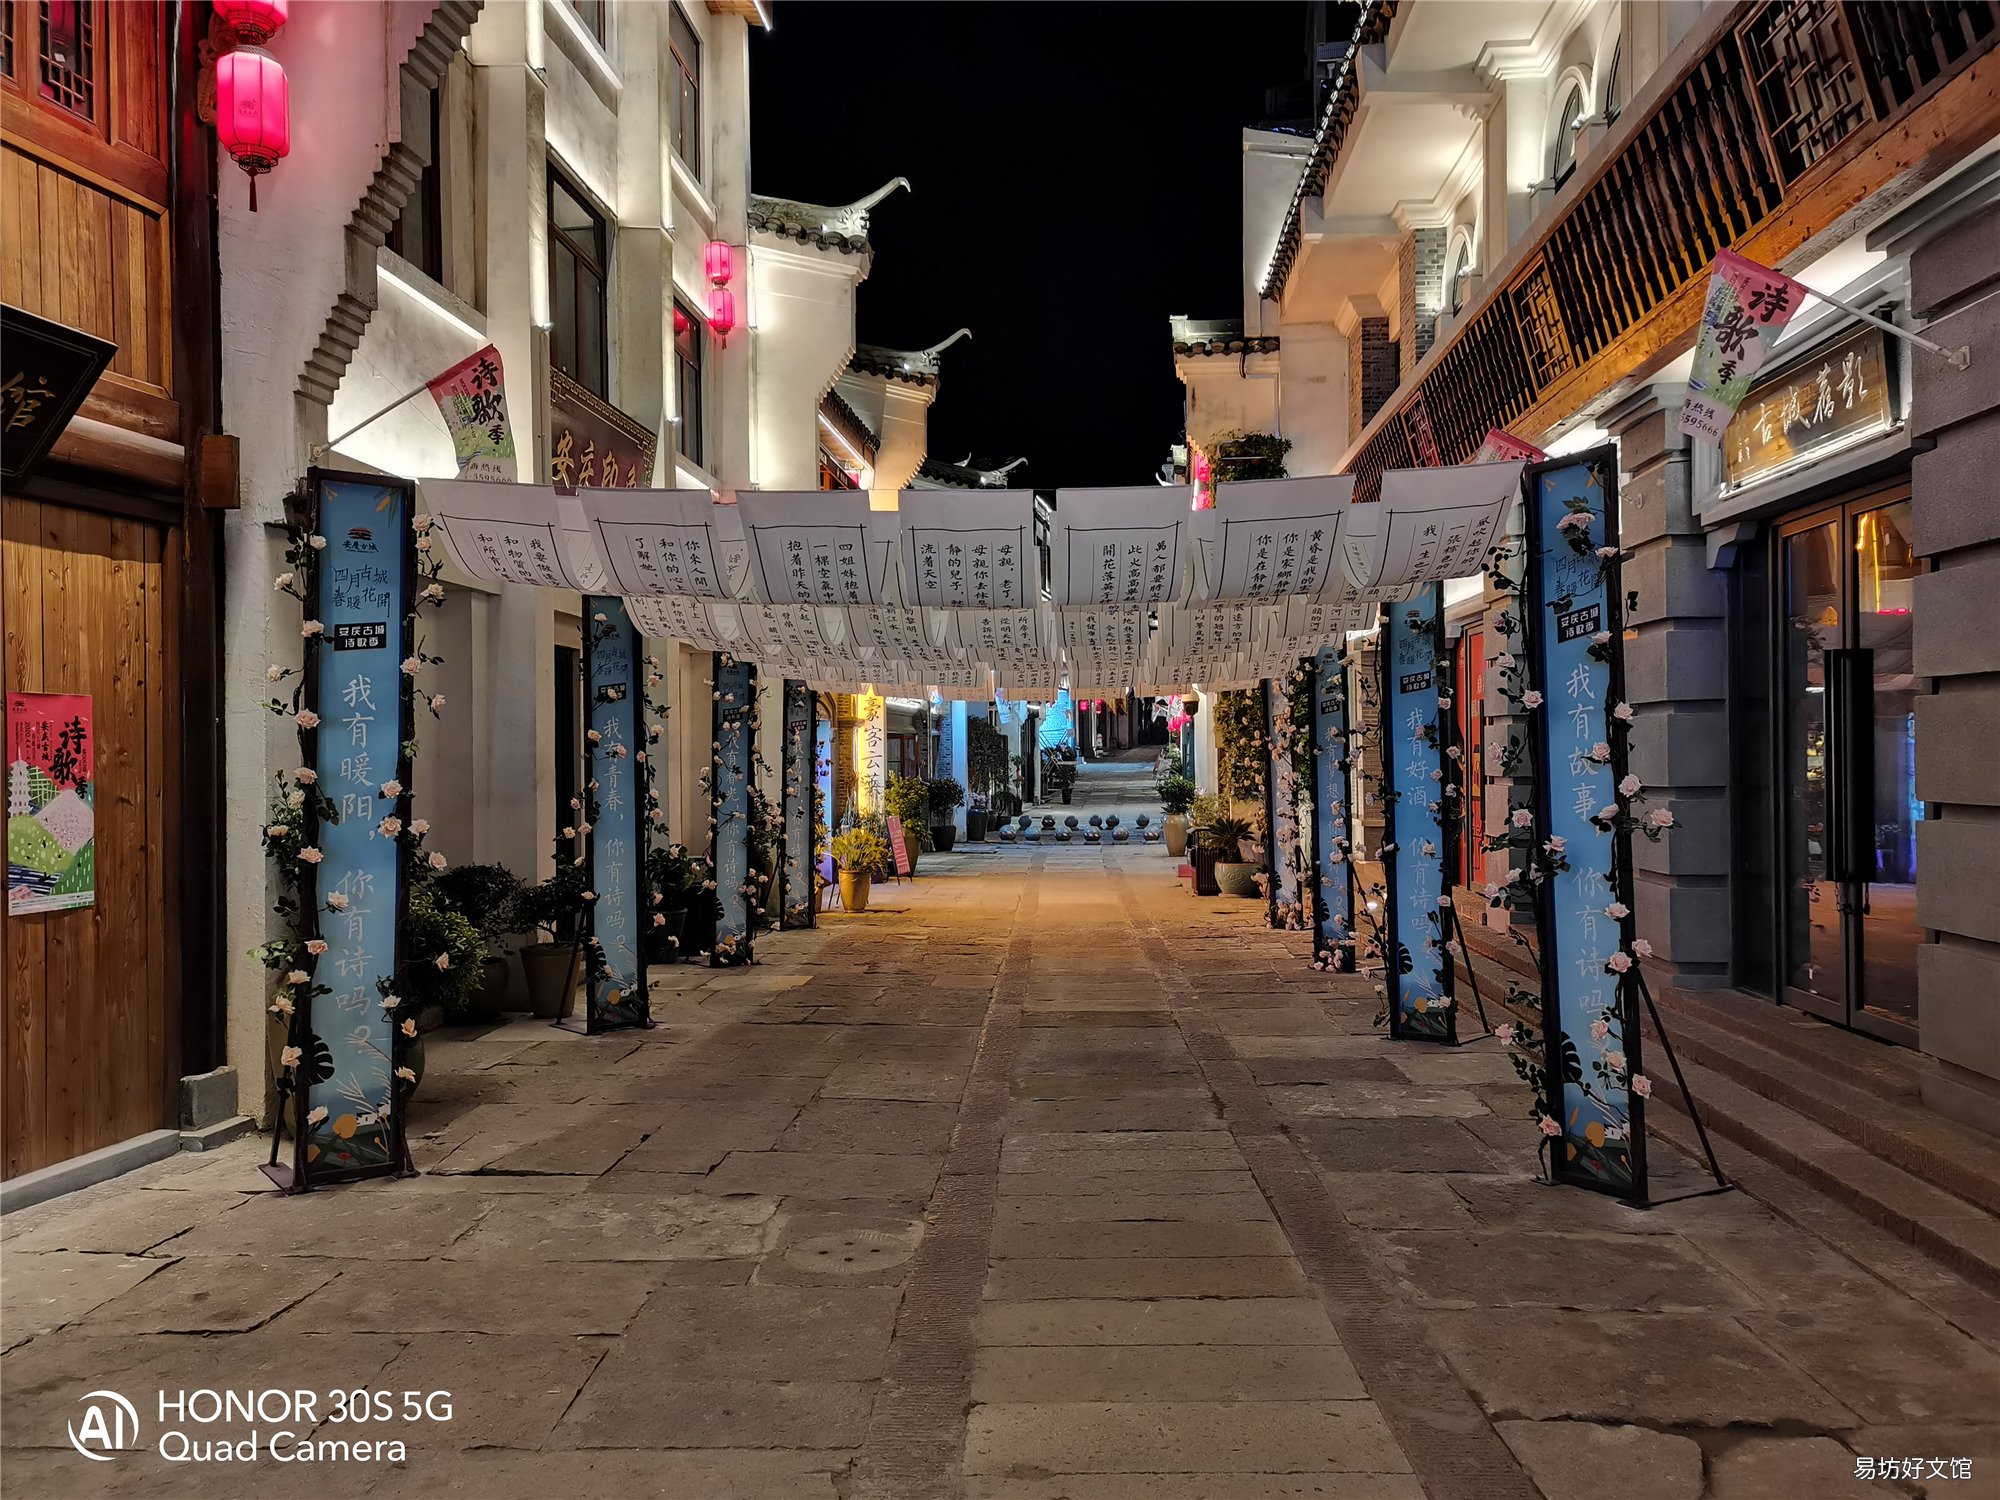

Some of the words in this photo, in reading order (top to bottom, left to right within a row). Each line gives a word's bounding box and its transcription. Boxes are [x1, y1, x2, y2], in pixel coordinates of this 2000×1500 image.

[1713, 282, 1790, 385] 诗歌季
[470, 357, 505, 445] 诗歌季
[49, 715, 89, 799] 诗歌季
